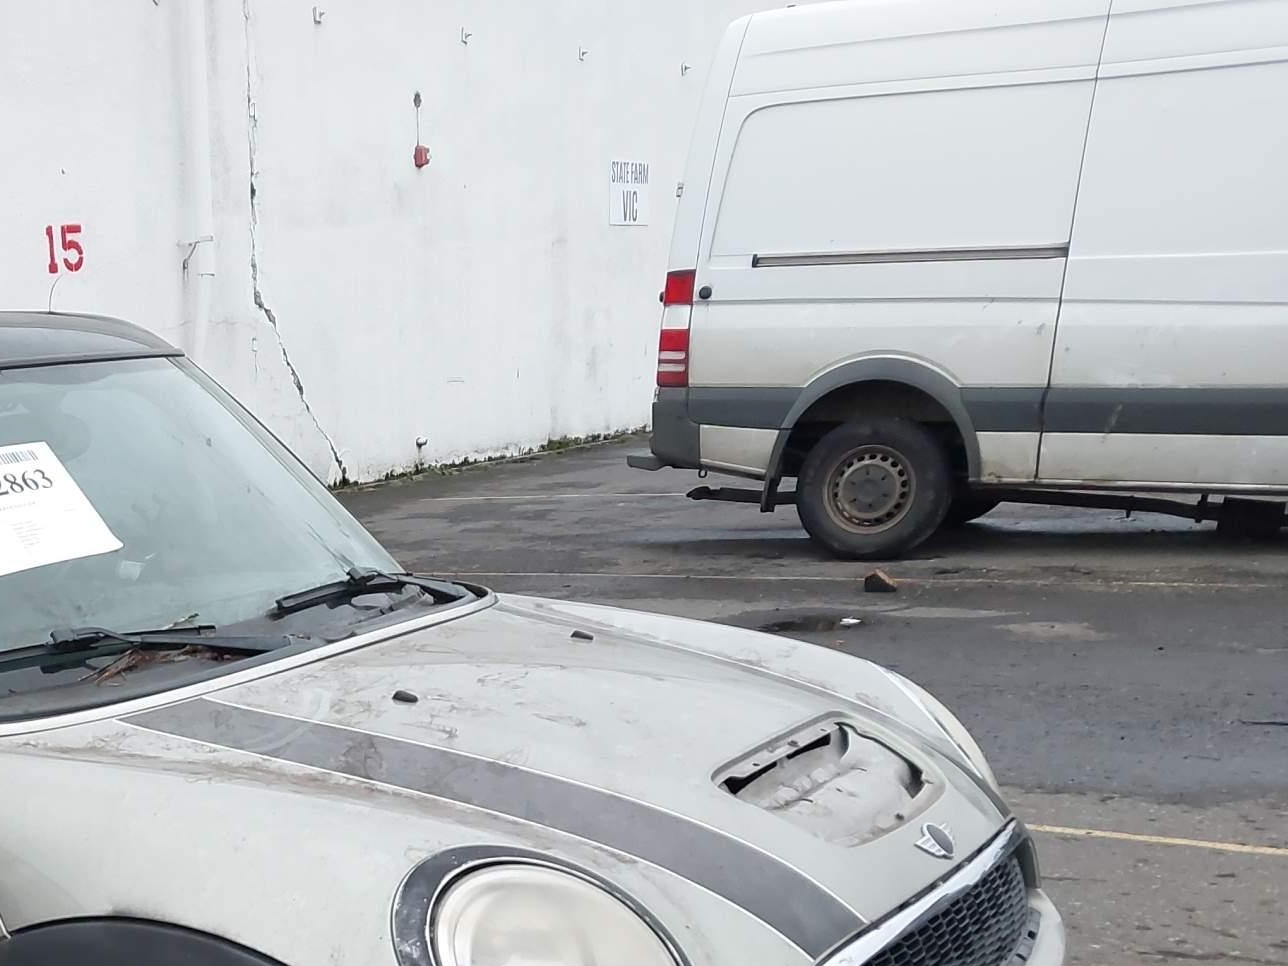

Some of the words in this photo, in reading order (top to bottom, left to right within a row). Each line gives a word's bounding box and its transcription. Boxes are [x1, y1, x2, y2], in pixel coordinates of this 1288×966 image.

[611, 161, 630, 184] STATE
[630, 162, 649, 185] FARM
[622, 190, 638, 222] VIC
[46, 225, 84, 273] 15
